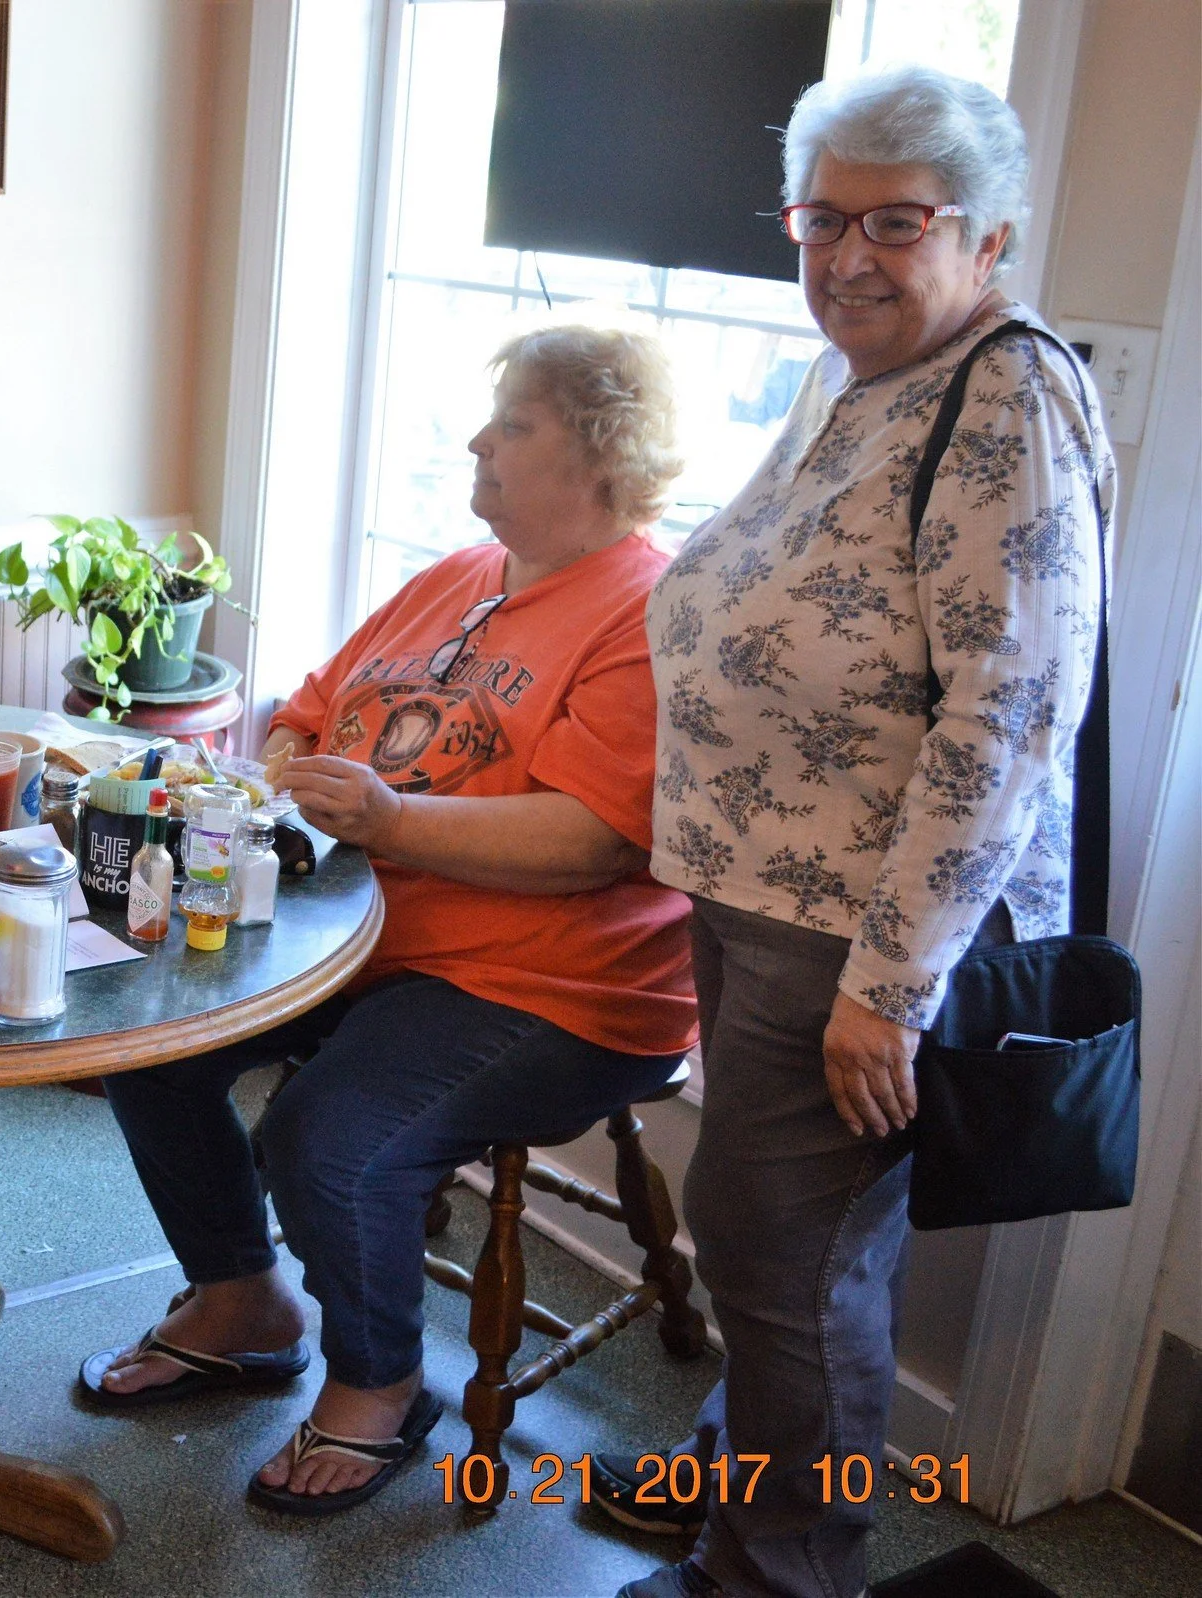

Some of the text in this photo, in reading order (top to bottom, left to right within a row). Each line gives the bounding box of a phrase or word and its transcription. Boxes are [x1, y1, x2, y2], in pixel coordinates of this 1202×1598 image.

[440, 720, 500, 762] 1954
[90, 831, 131, 868] HE
[81, 870, 130, 895] ANCHO
[103, 867, 122, 880] my
